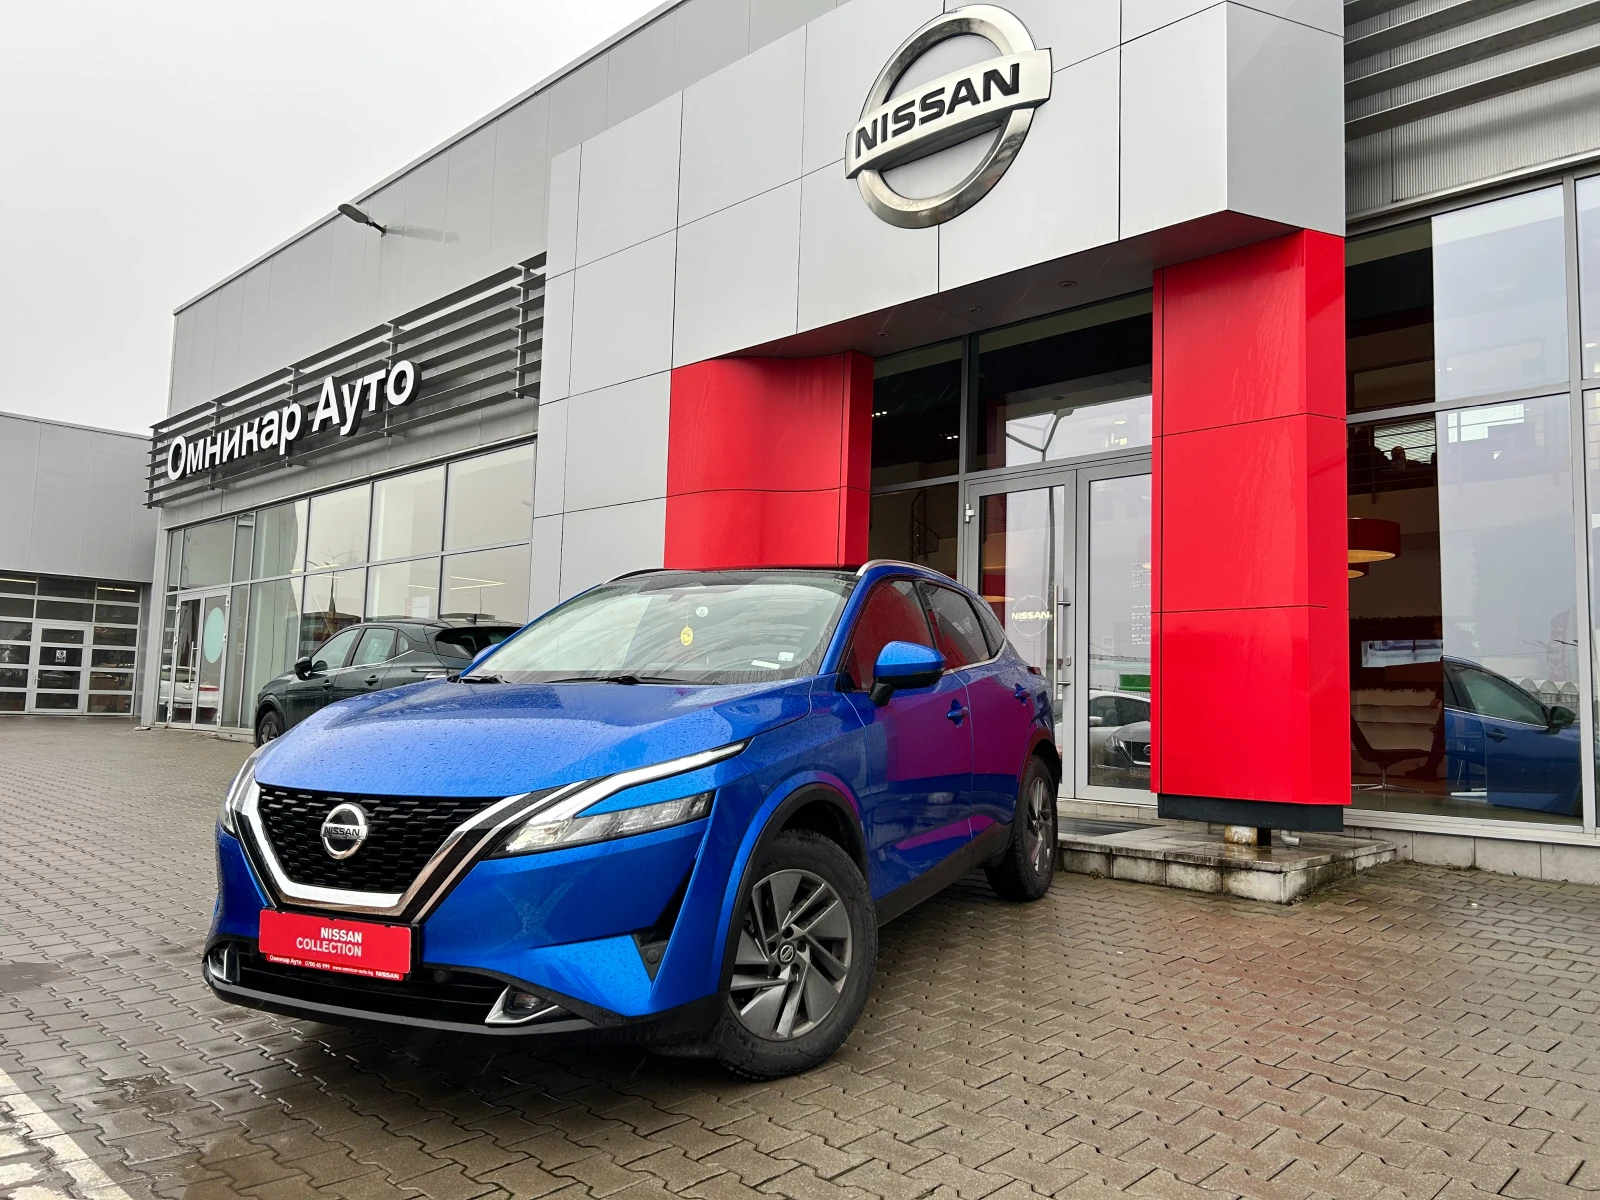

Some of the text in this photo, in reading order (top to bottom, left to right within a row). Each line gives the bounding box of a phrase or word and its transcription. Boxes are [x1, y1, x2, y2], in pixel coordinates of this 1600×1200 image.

[855, 63, 1020, 159] NISSAN
[167, 360, 416, 481] Омникар Ауто
[1011, 611, 1050, 620] NISSAN
[324, 826, 361, 837] NISSAN
[321, 928, 362, 943] NISSAN
[296, 937, 362, 957] COLLECTION
[375, 970, 400, 980] NISSAN
